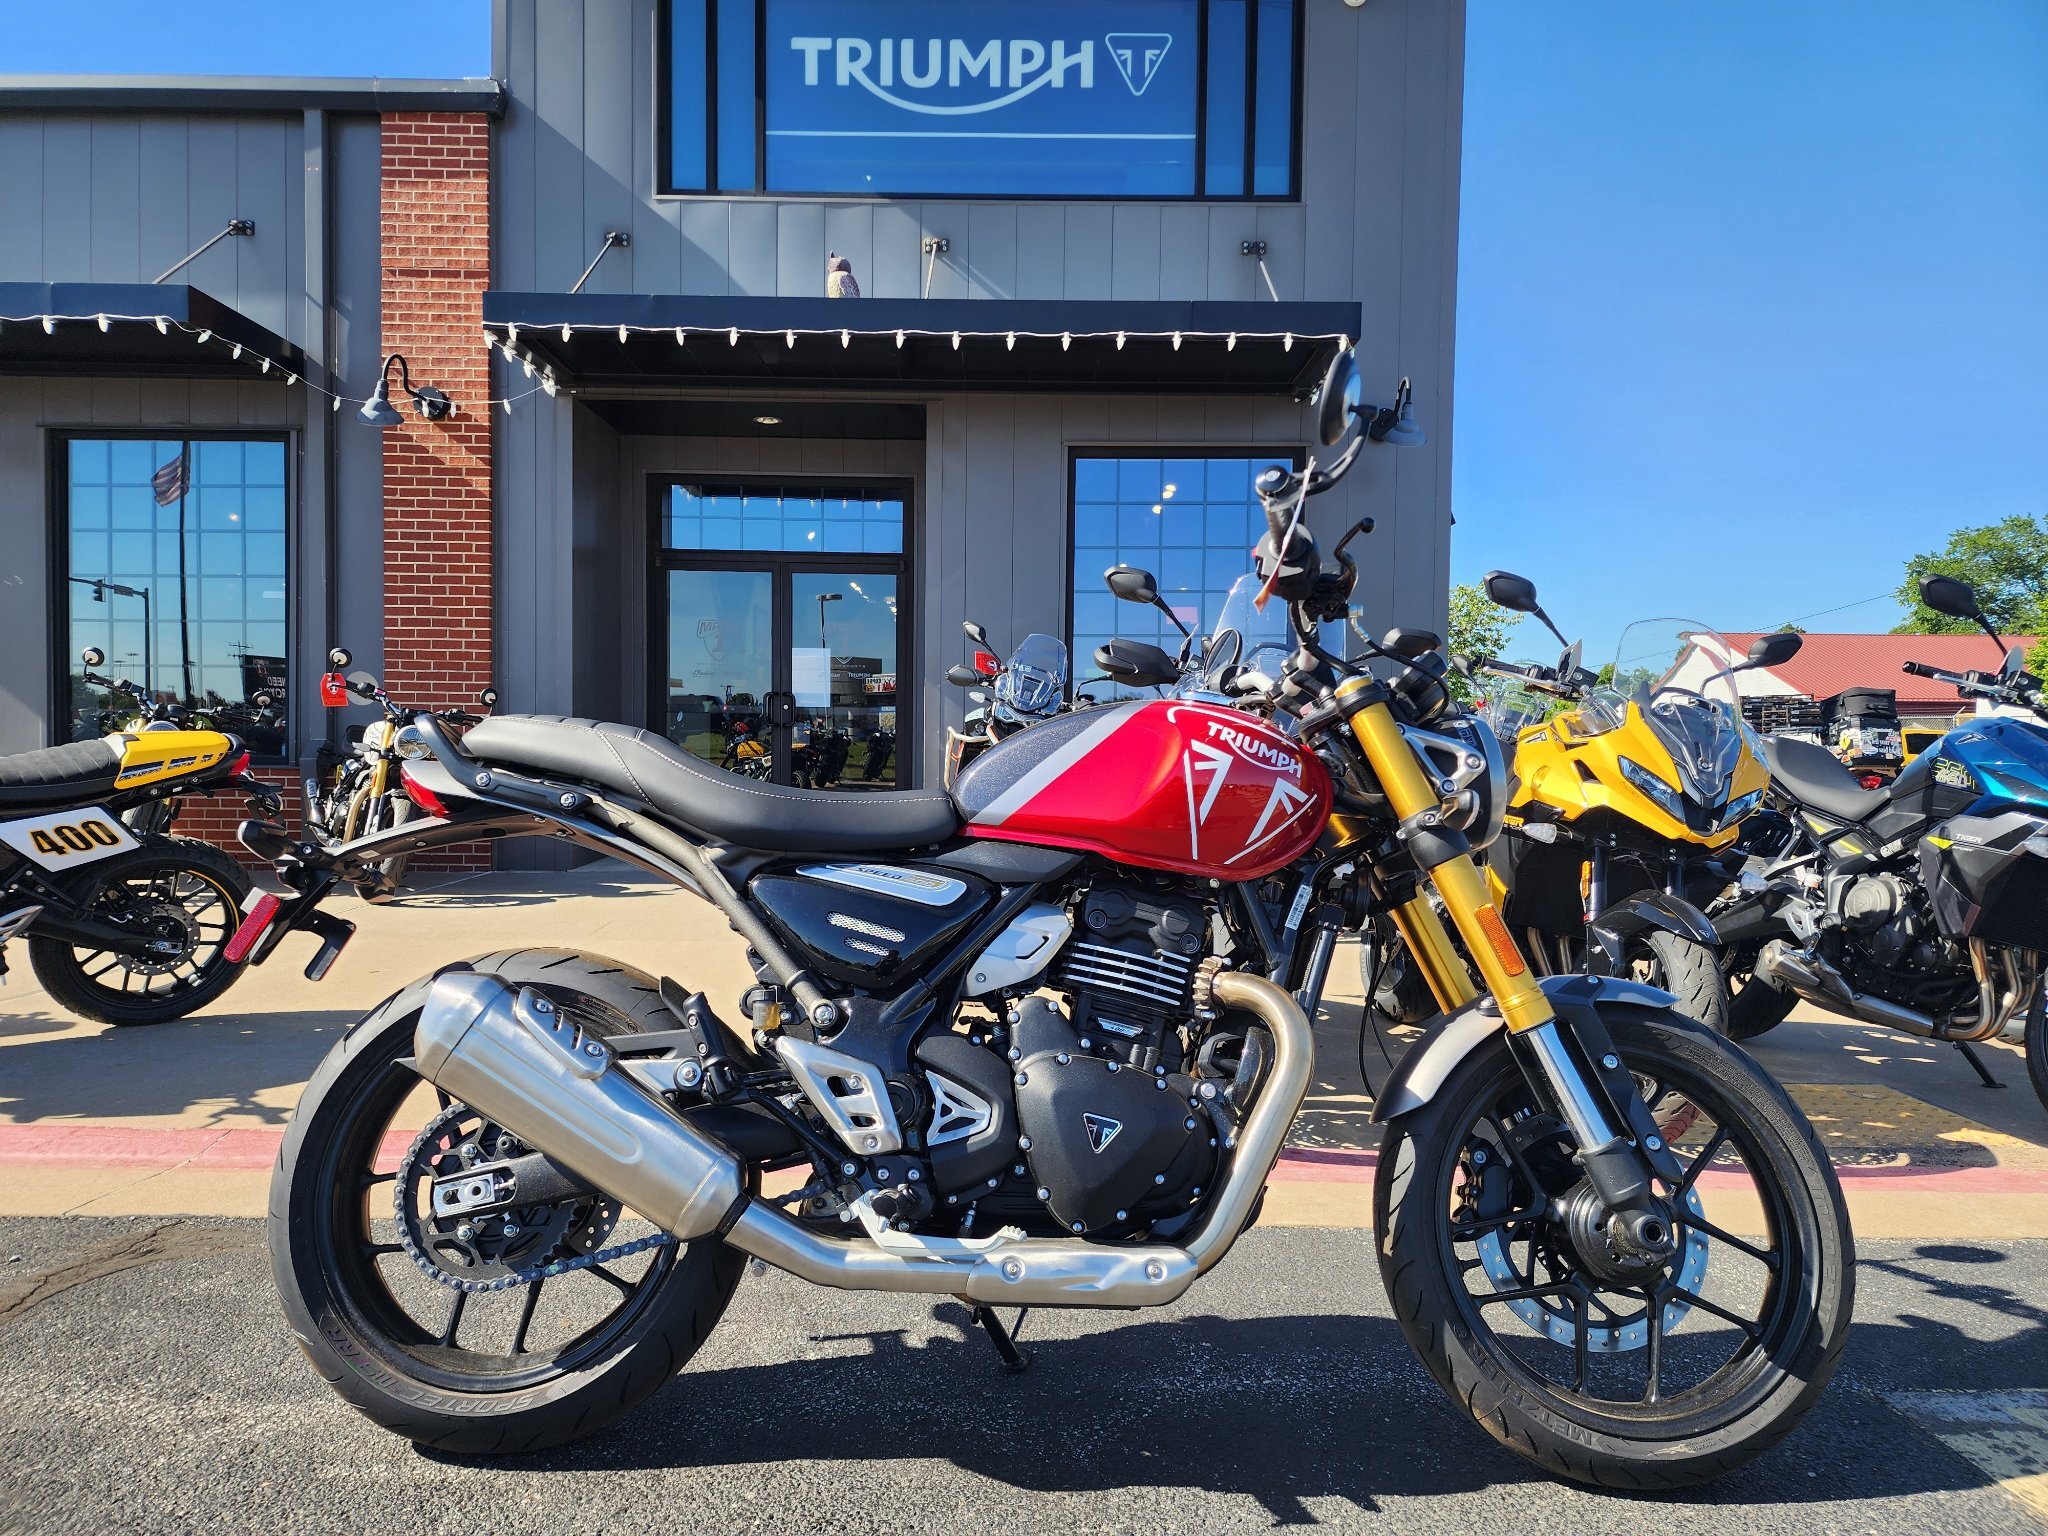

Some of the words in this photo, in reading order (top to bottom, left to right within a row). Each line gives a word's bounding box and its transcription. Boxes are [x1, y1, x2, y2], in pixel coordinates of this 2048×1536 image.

[791, 37, 1094, 115] TRIUMPH
[1207, 721, 1303, 779] TRIUMPH
[29, 820, 121, 855] 400
[399, 1386, 541, 1414] SPORTEC
